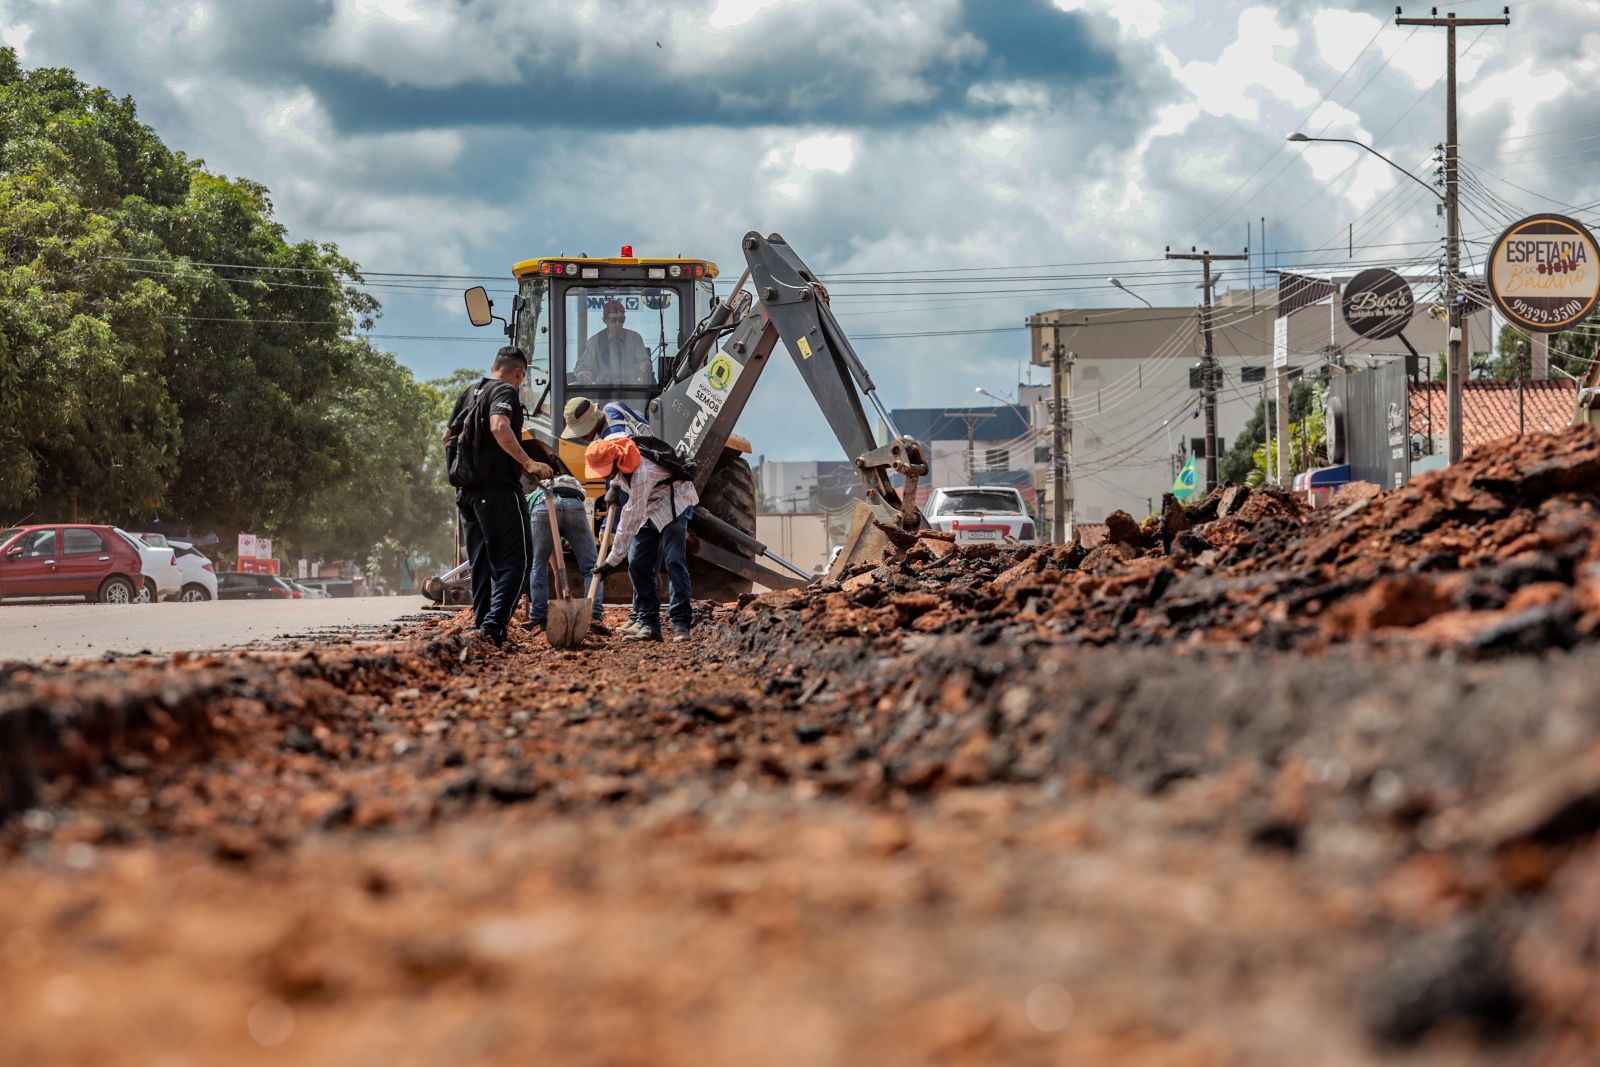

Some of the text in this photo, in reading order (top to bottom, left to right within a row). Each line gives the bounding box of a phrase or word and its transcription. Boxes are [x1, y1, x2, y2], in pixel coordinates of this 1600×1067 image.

[1506, 241, 1586, 263] ESPETARIA
[1511, 299, 1582, 323] 99329-3500
[695, 390, 720, 413] SEMOB
[684, 409, 712, 449] XCM
